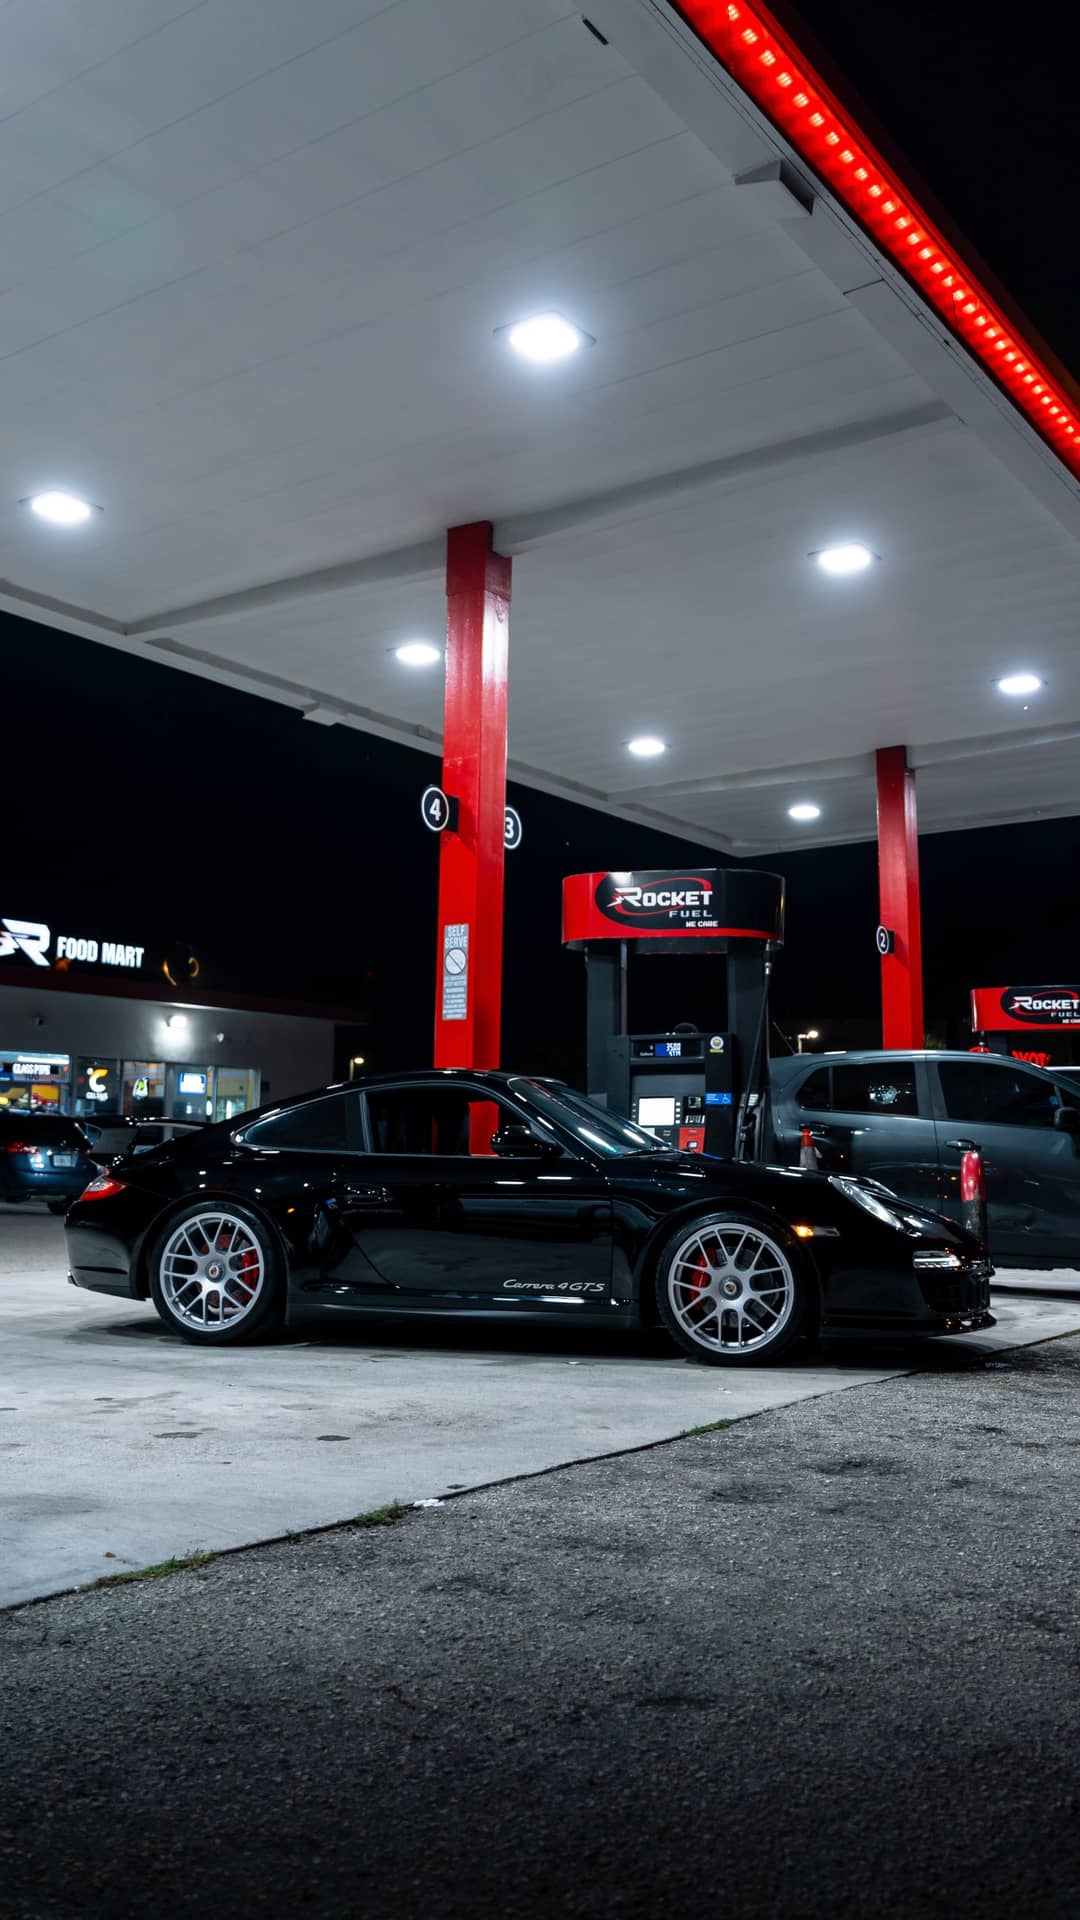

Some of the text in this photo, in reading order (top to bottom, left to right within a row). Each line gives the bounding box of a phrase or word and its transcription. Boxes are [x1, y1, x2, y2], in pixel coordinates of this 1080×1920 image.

[429, 798, 441, 821] 4
[504, 816, 514, 839] 3
[612, 886, 712, 907] ROCKET
[668, 909, 712, 918] FUEL
[447, 925, 465, 937] SELF
[445, 936, 468, 949] SERVE
[880, 932, 886, 948] 2
[56, 935, 98, 962] FOOD
[101, 941, 145, 968] MART
[1012, 996, 1080, 1010] ROCKET
[503, 1279, 555, 1290] Carrera
